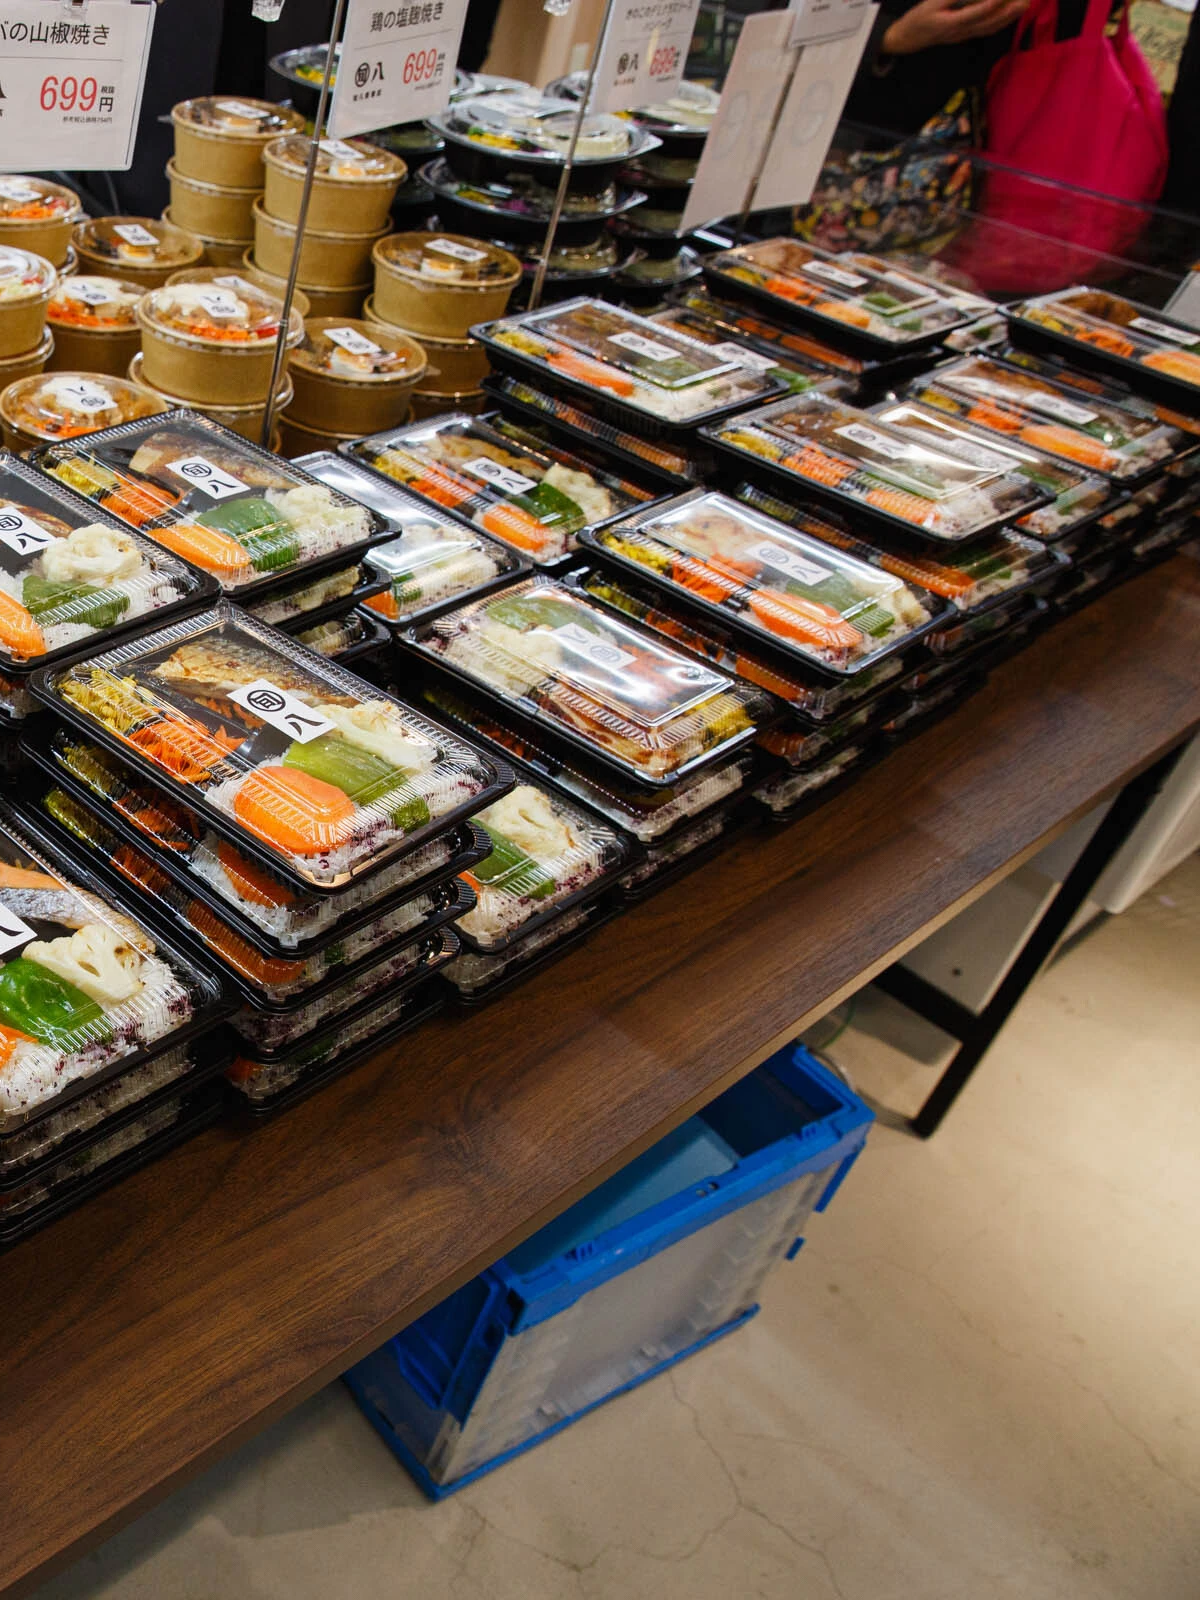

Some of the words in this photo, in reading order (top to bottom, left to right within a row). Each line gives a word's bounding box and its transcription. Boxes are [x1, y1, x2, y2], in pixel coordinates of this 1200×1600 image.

[403, 48, 437, 84] 699
[40, 76, 98, 112] 699
[99, 97, 114, 113] 円
[246, 689, 327, 737] 旬八
